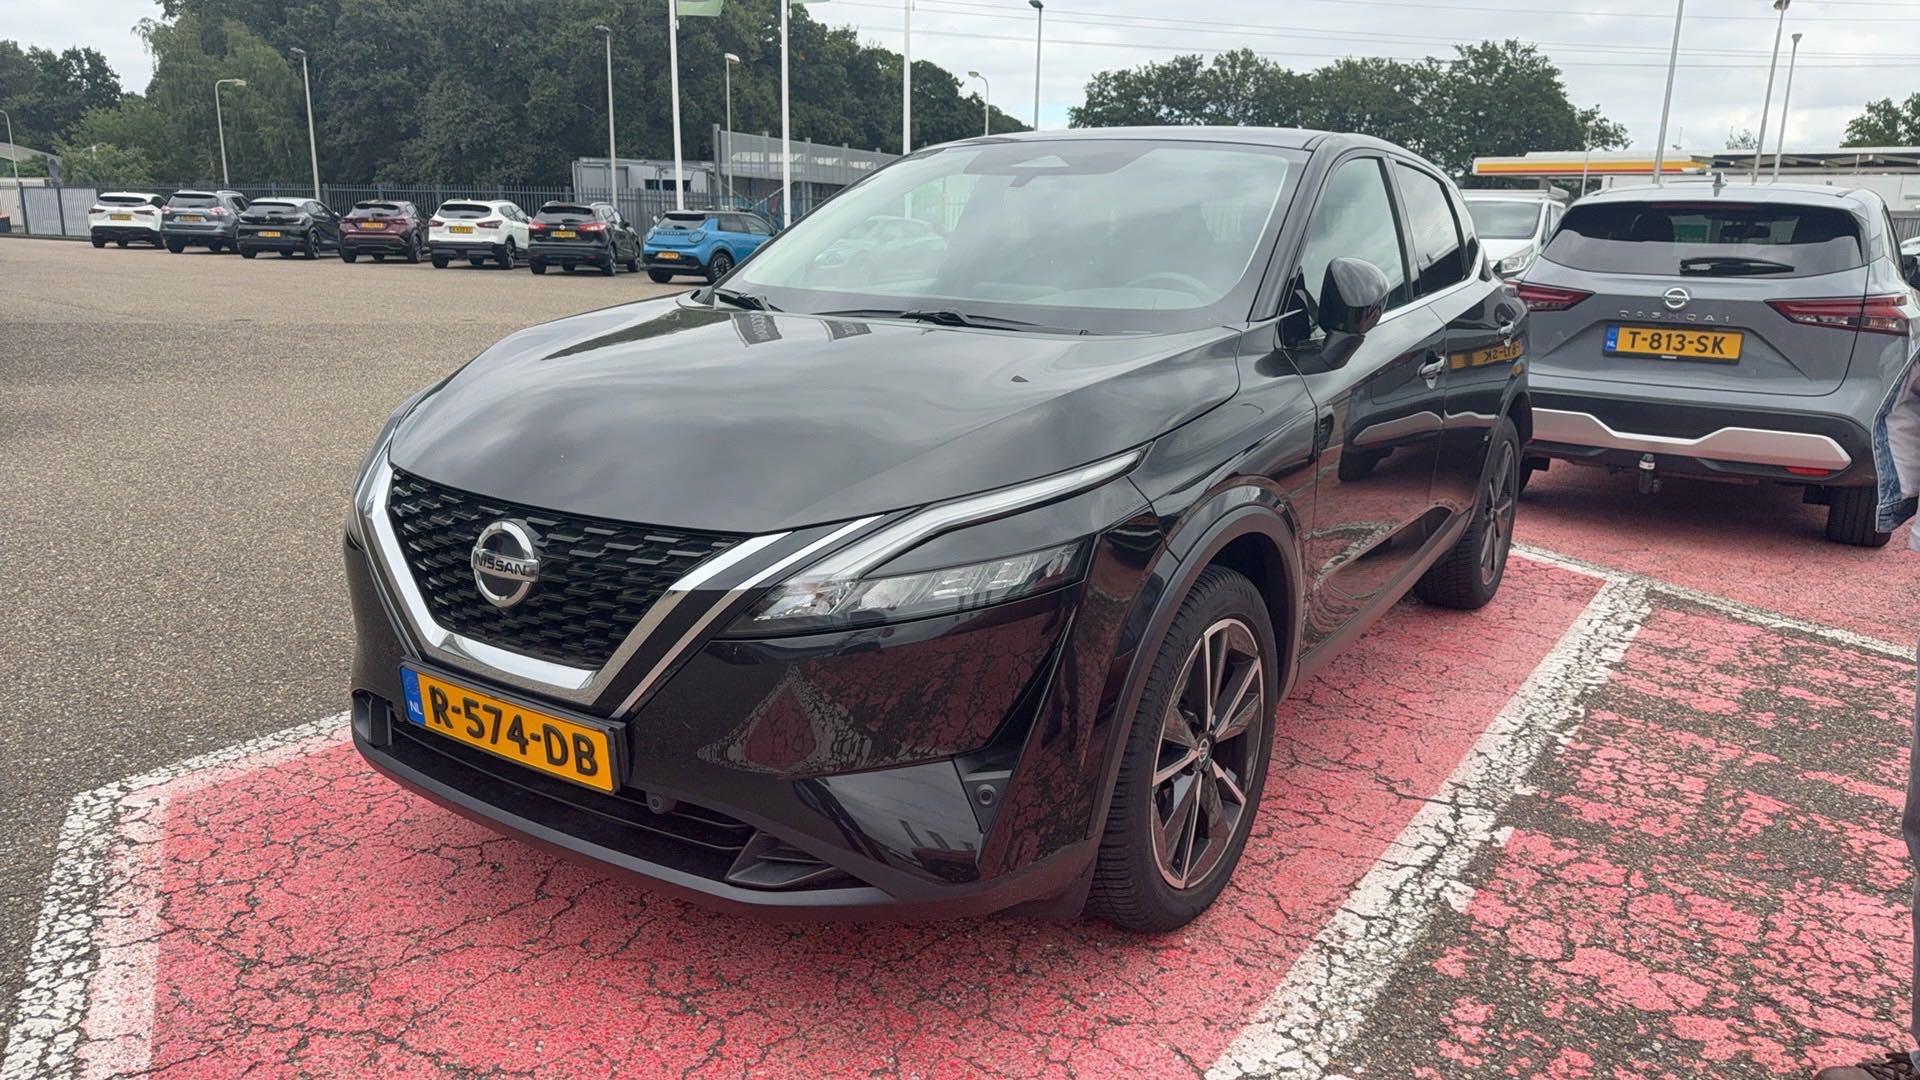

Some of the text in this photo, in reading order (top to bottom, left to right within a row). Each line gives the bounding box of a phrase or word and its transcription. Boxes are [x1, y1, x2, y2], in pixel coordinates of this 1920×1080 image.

[1629, 331, 1726, 354] T-813-SK
[475, 553, 527, 576] NISSAN
[410, 701, 423, 716] NL
[428, 685, 599, 777] R-574-DB
